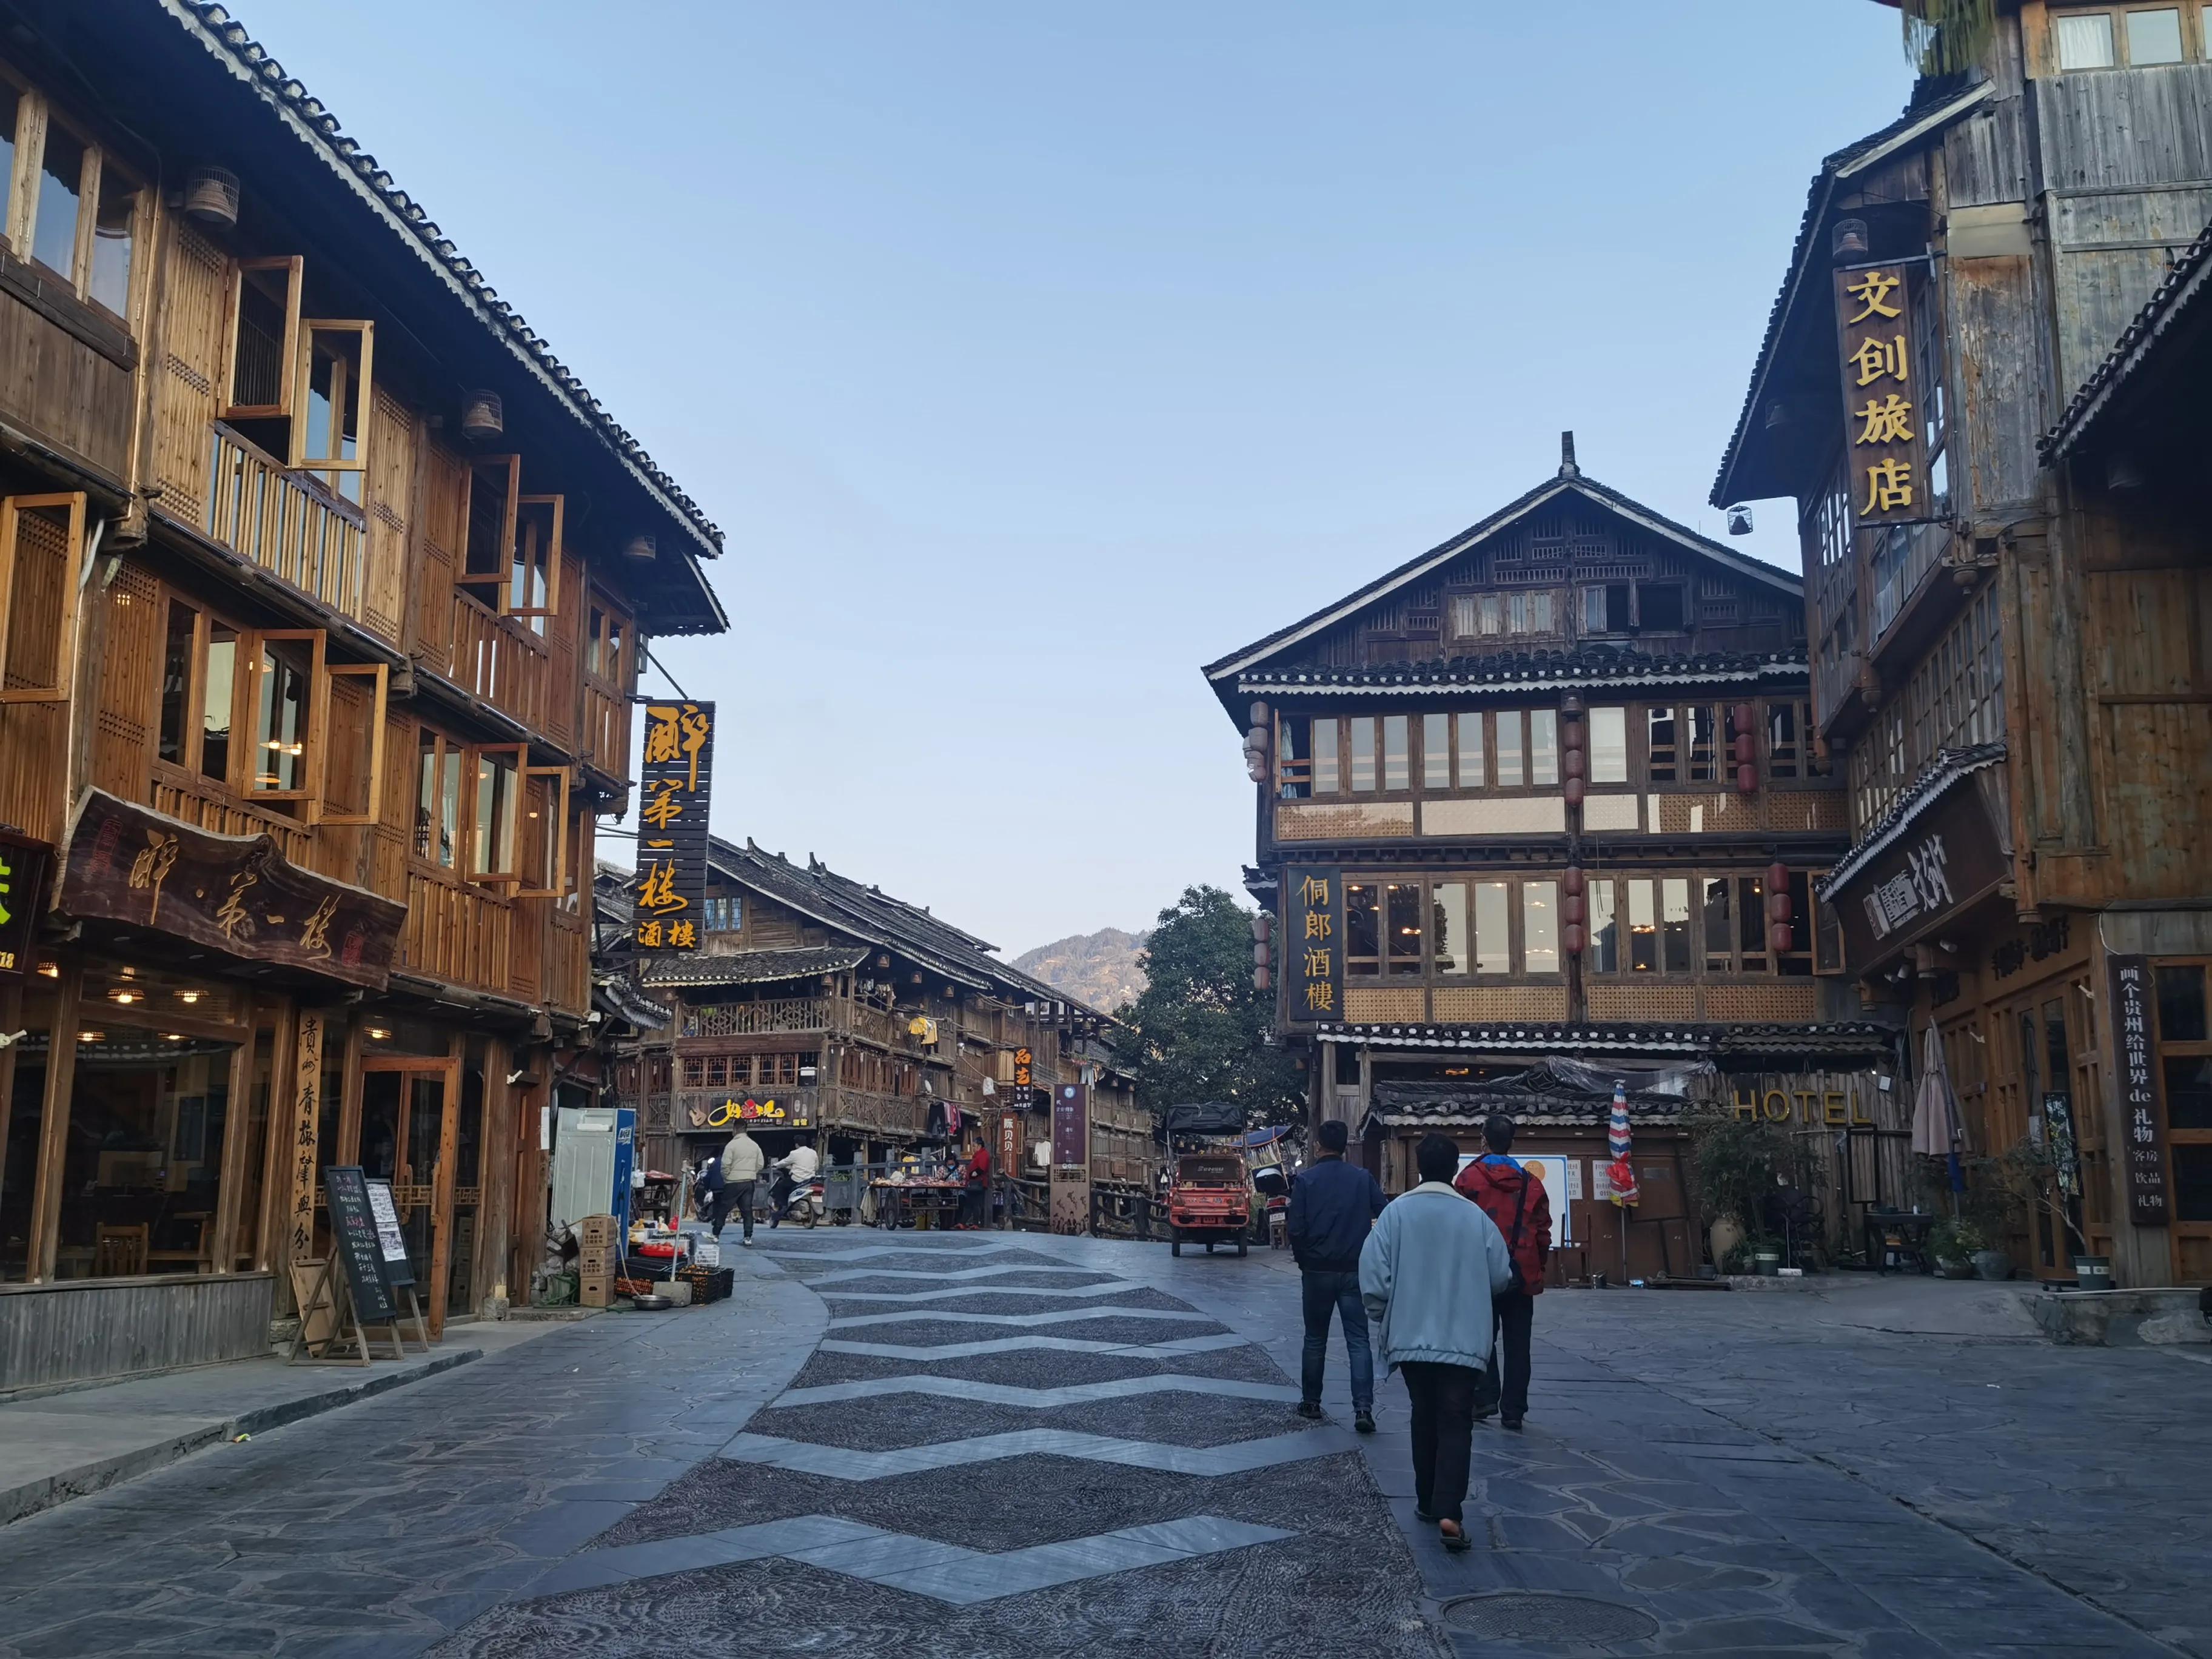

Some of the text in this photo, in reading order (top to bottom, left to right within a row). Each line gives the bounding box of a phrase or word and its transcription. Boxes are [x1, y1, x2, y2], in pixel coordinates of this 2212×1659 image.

[1847, 272, 1914, 517] 文创旅店
[1296, 875, 1335, 1011] 侗郎酒樓
[0, 951, 15, 969] 18
[1733, 1090, 1872, 1124] HOTEL
[1004, 1118, 1013, 1151] 陈贝贝
[2133, 1150, 2158, 1162] 客房
[2135, 1172, 2160, 1184] 饮品
[2138, 1195, 2163, 1207] 礼物
